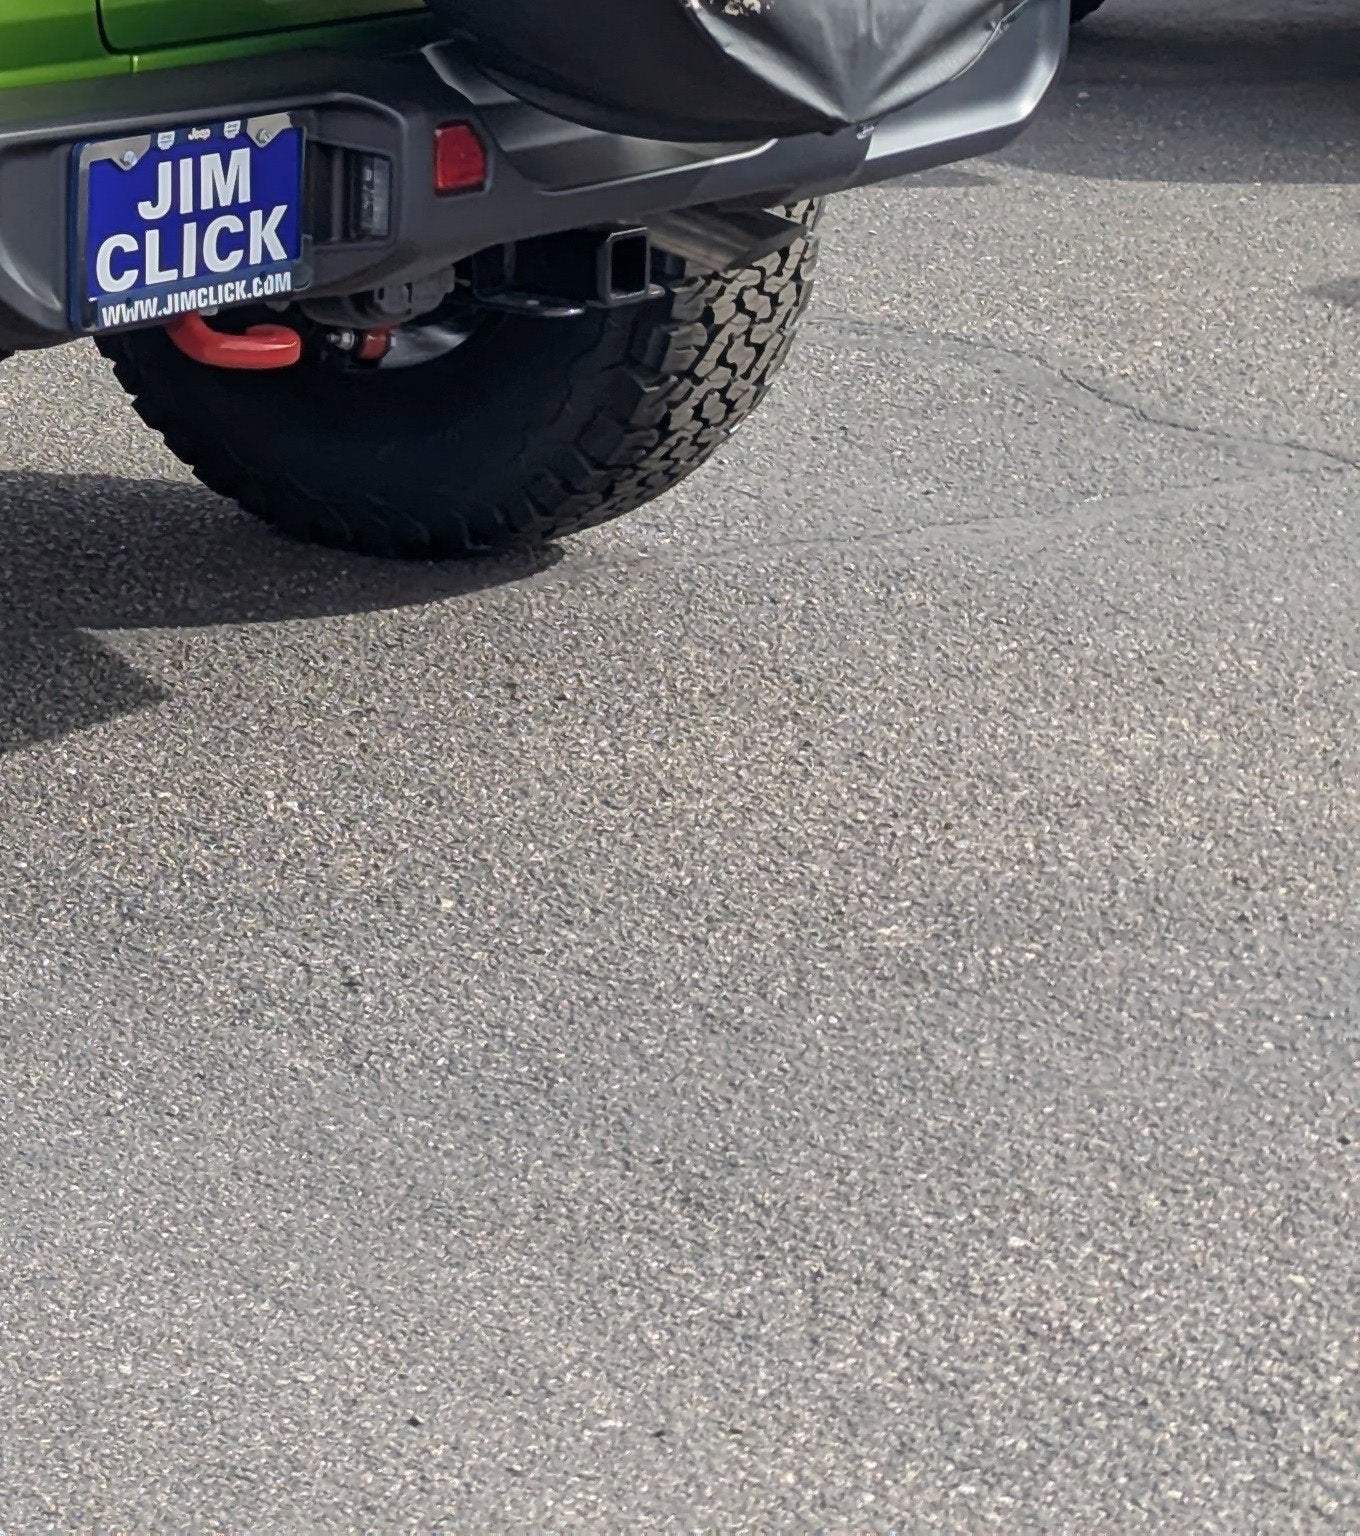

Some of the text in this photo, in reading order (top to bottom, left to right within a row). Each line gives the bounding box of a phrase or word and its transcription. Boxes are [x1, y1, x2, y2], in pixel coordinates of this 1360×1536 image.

[137, 147, 251, 220] JIM
[96, 204, 288, 293] CLICK
[101, 271, 292, 328] WWW.JIMCLICK.COM
